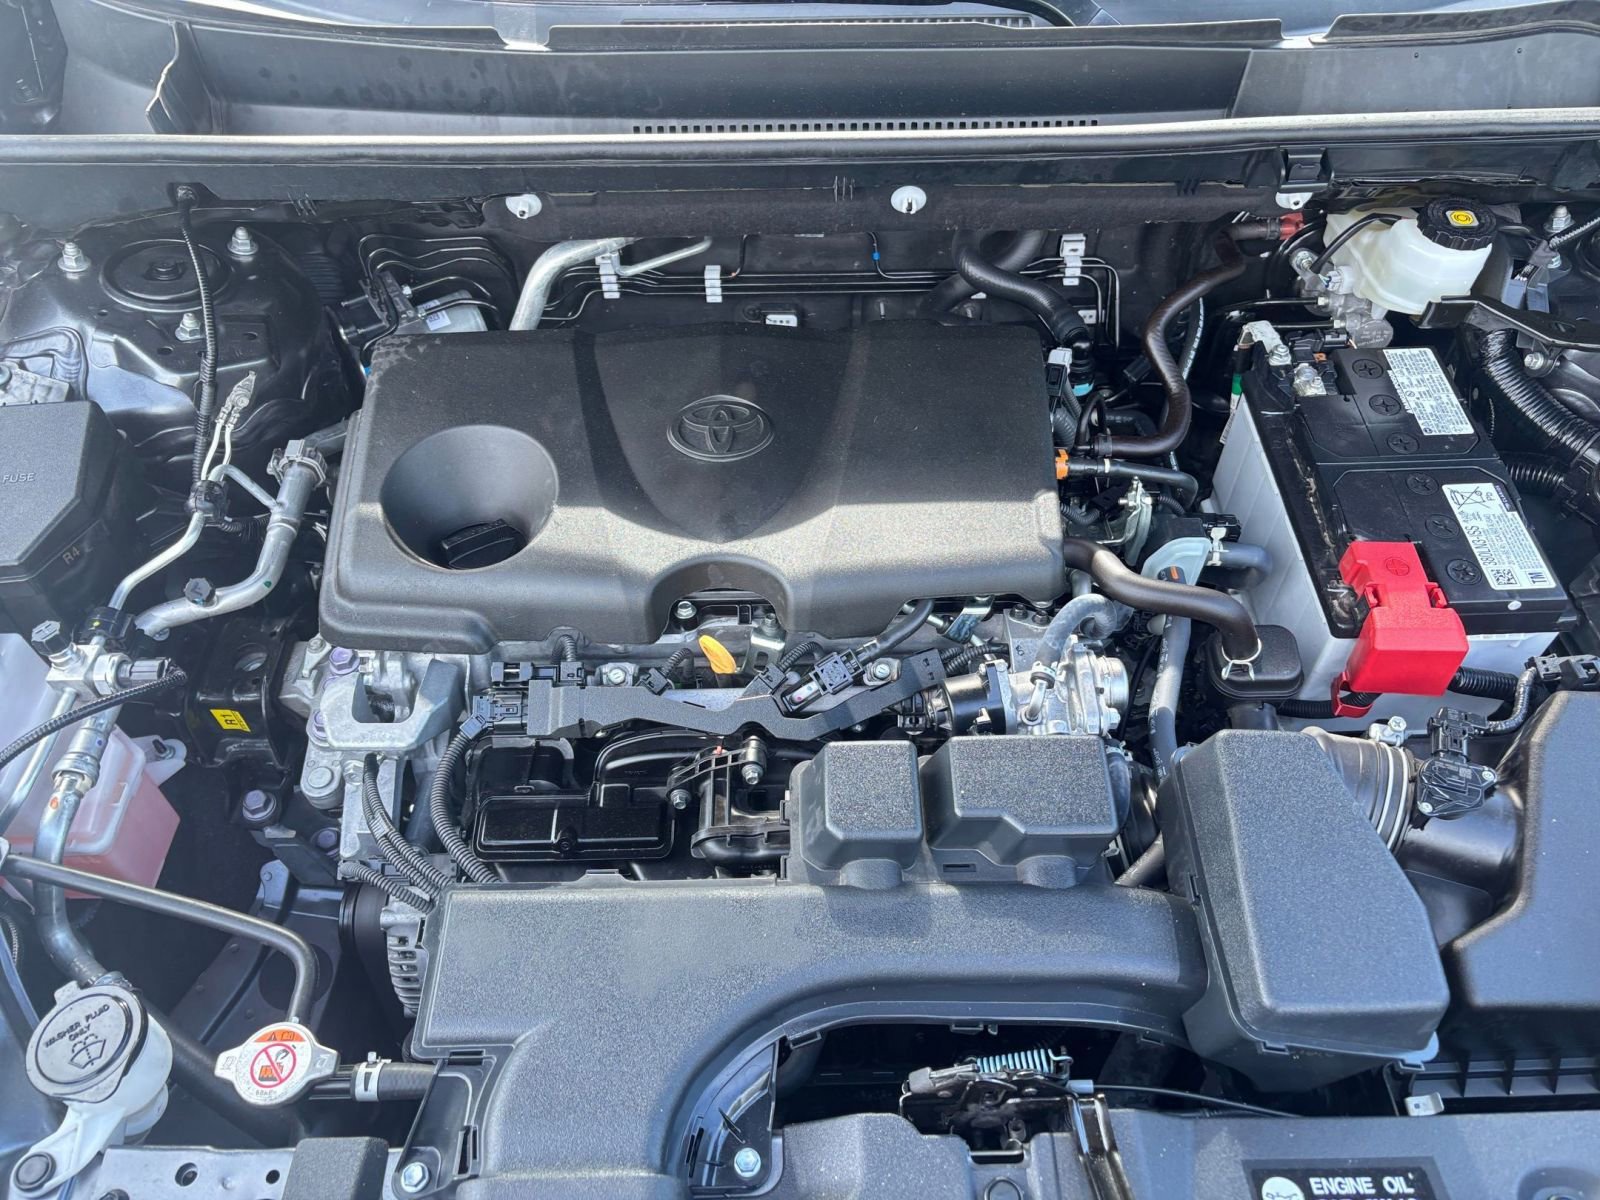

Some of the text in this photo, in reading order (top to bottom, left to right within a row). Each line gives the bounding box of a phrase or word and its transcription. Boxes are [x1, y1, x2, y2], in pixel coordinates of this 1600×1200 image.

[3, 472, 35, 483] FUSE
[1485, 491, 1497, 502] Pb
[62, 546, 80, 565] R4
[1527, 571, 1549, 585] TM
[44, 1003, 110, 1048] WASHER FLUID
[68, 1023, 91, 1042] ONLY
[1308, 1176, 1415, 1195] ENGINE OIL
